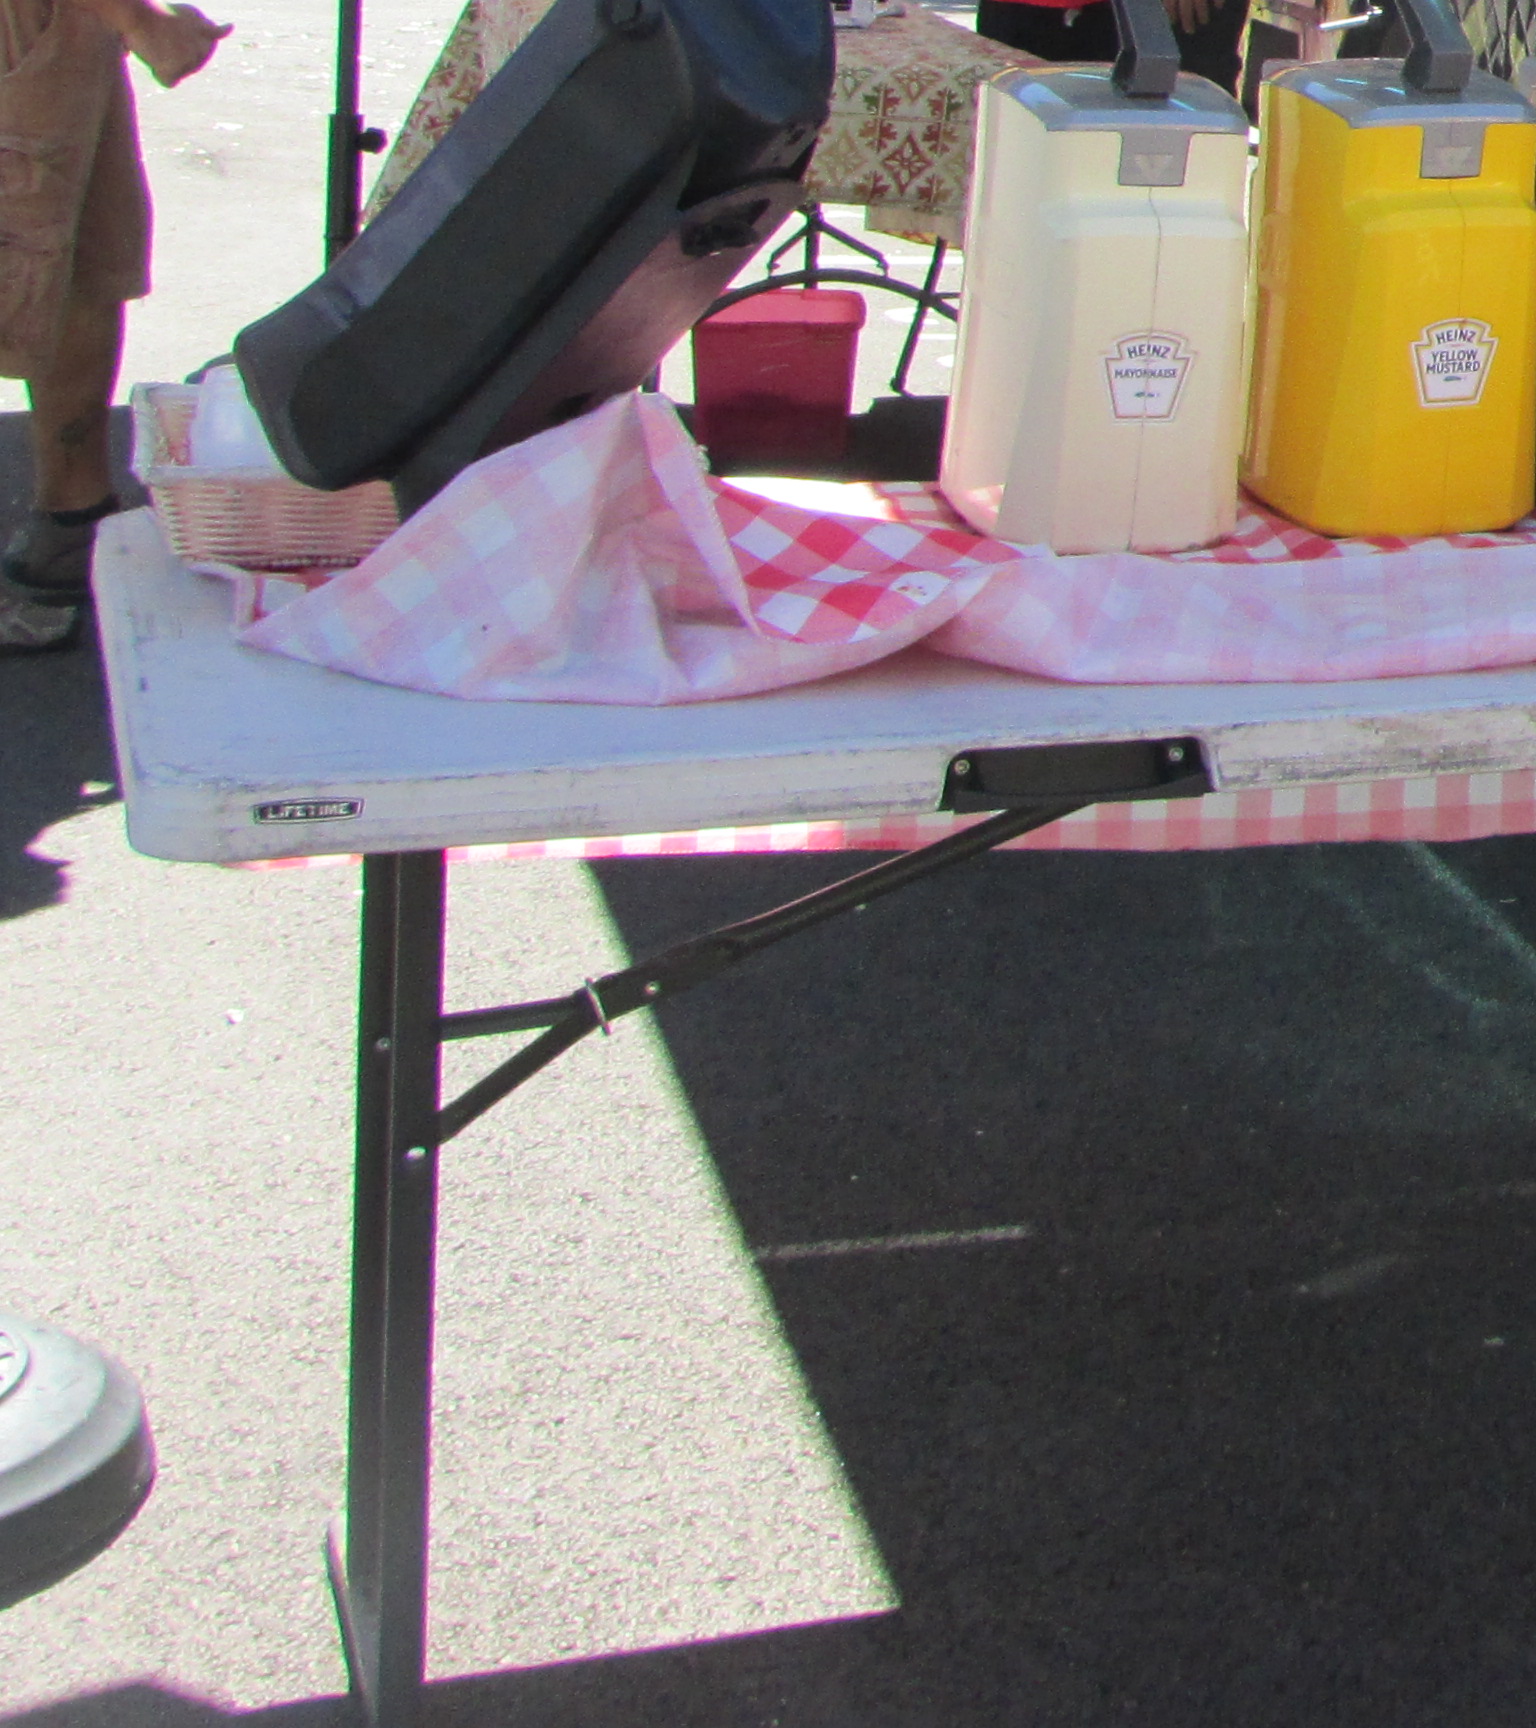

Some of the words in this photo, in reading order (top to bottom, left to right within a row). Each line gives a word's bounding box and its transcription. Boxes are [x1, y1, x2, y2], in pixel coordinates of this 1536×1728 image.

[1436, 330, 1476, 344] HEINZ
[1127, 344, 1171, 359] HEINZ
[1431, 350, 1478, 363] YELLOW
[1115, 368, 1178, 379] MAYONNAISE
[1426, 361, 1480, 374] MUSTARD
[266, 800, 349, 821] LIFETIME
